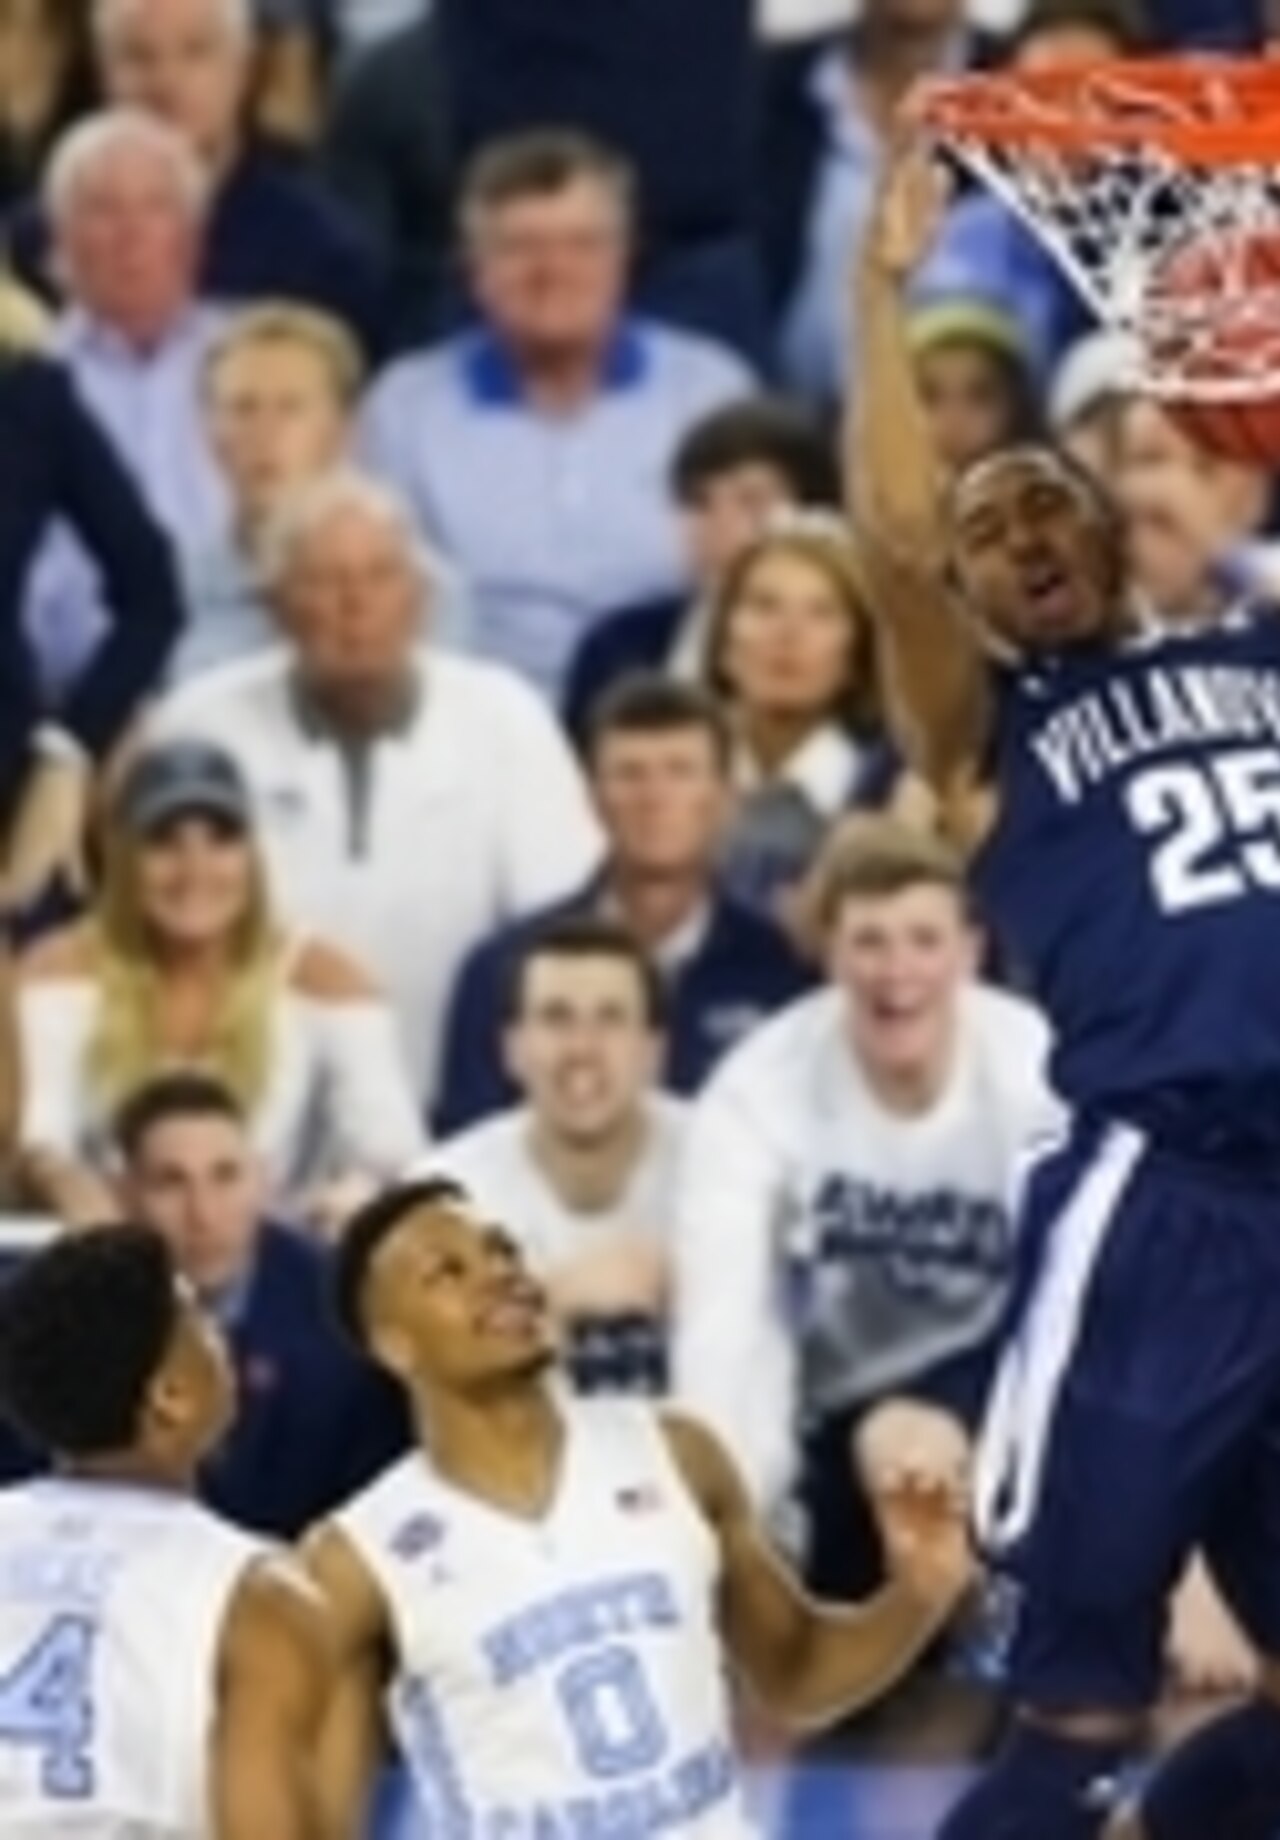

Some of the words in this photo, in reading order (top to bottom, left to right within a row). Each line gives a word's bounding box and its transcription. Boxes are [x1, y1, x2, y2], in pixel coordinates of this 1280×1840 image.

[480, 1570, 681, 1688] NORTH
[0, 1611, 98, 1799] 4
[557, 1645, 668, 1780] 0
